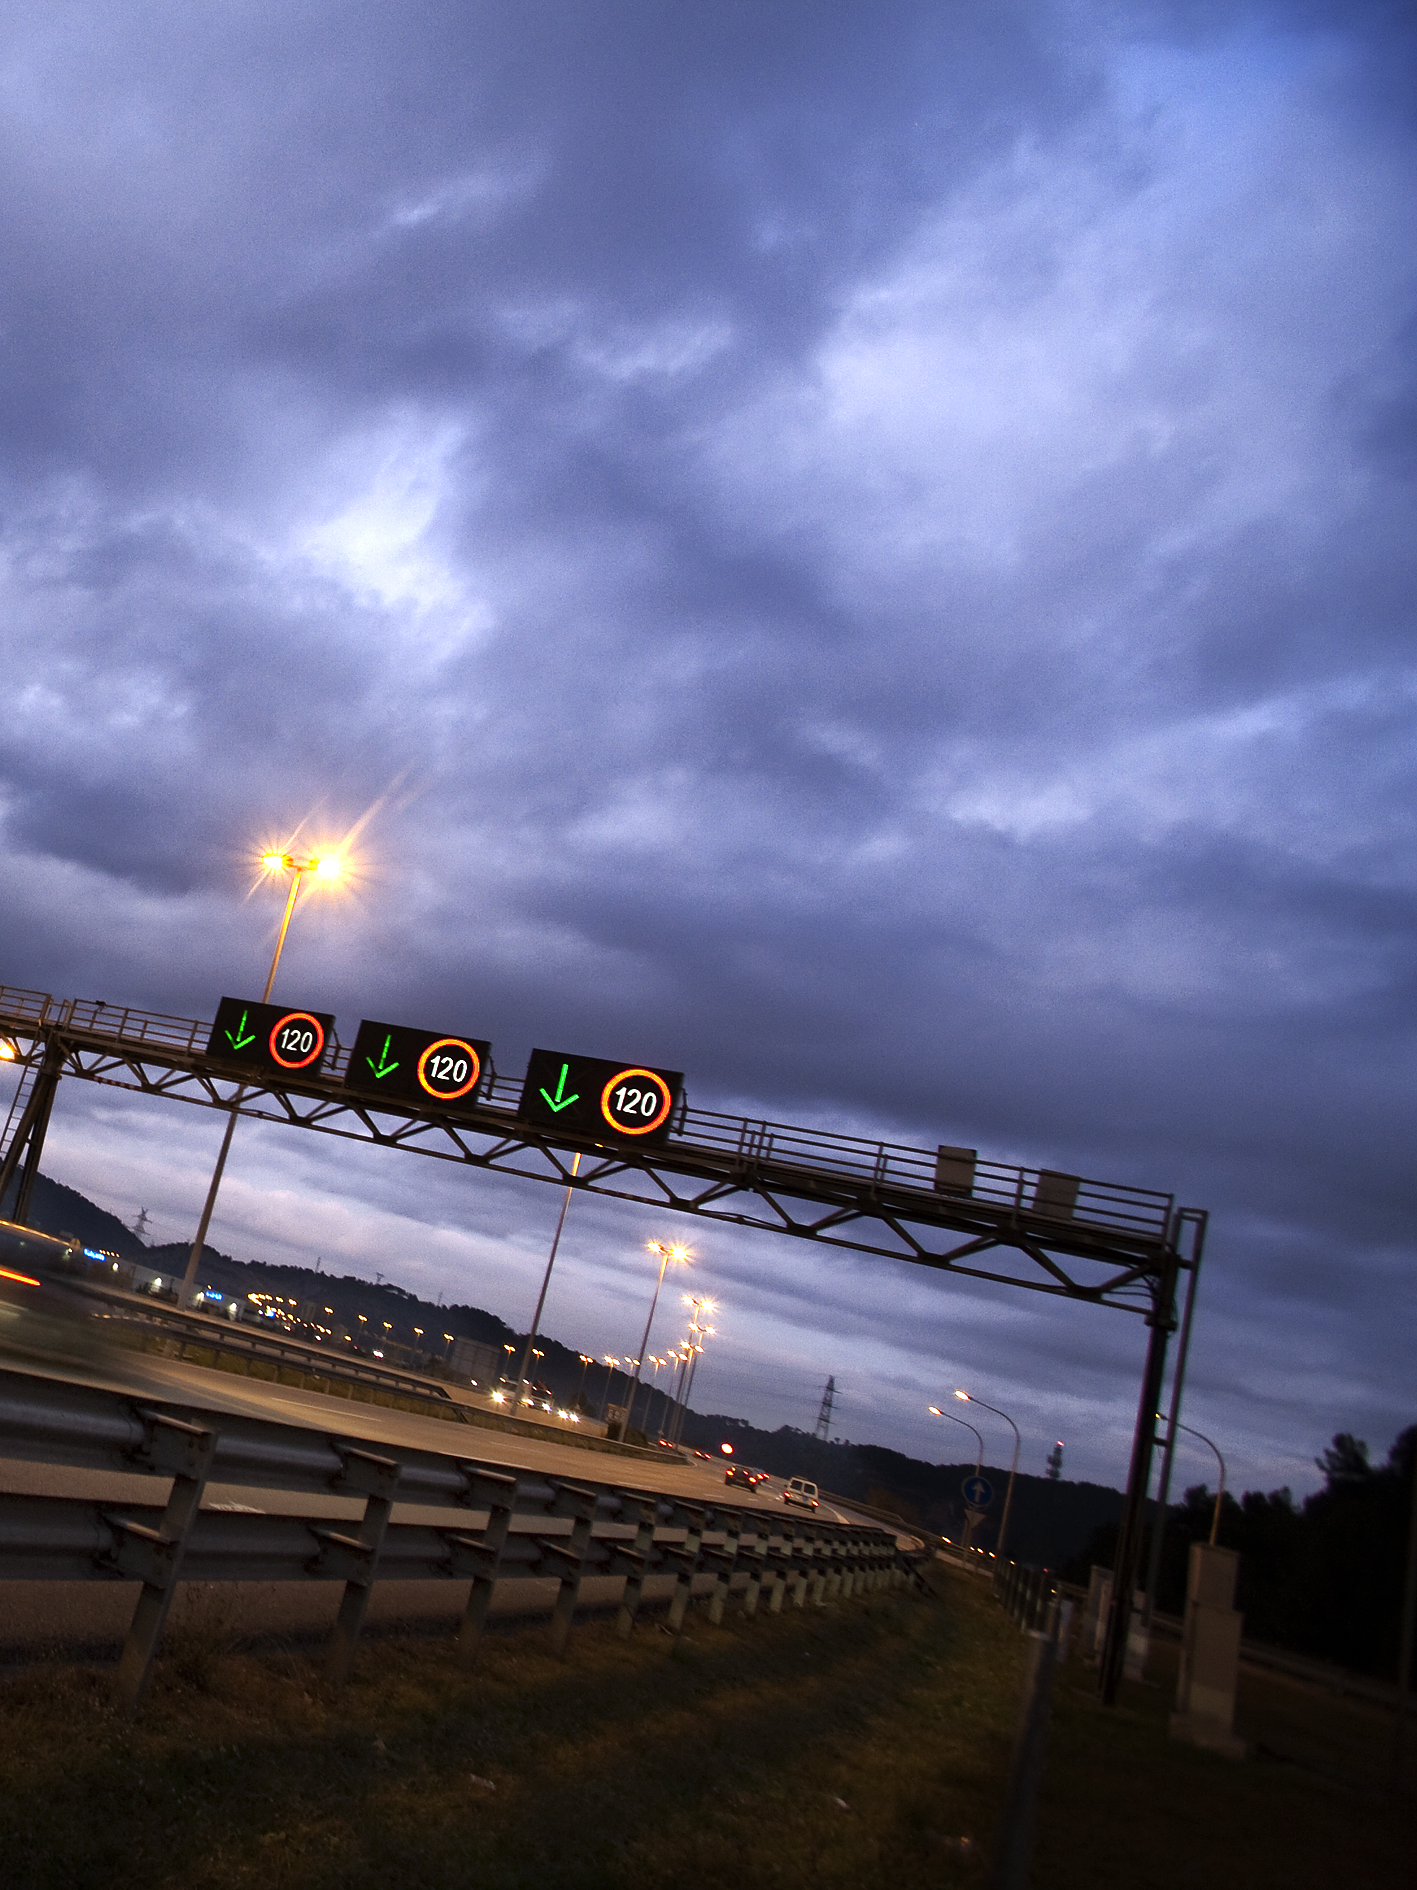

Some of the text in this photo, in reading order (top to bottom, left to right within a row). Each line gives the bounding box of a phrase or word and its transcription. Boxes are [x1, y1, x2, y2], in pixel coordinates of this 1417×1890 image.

[281, 1029, 313, 1053] 120
[430, 1055, 468, 1083] 120
[614, 1086, 657, 1117] 120
